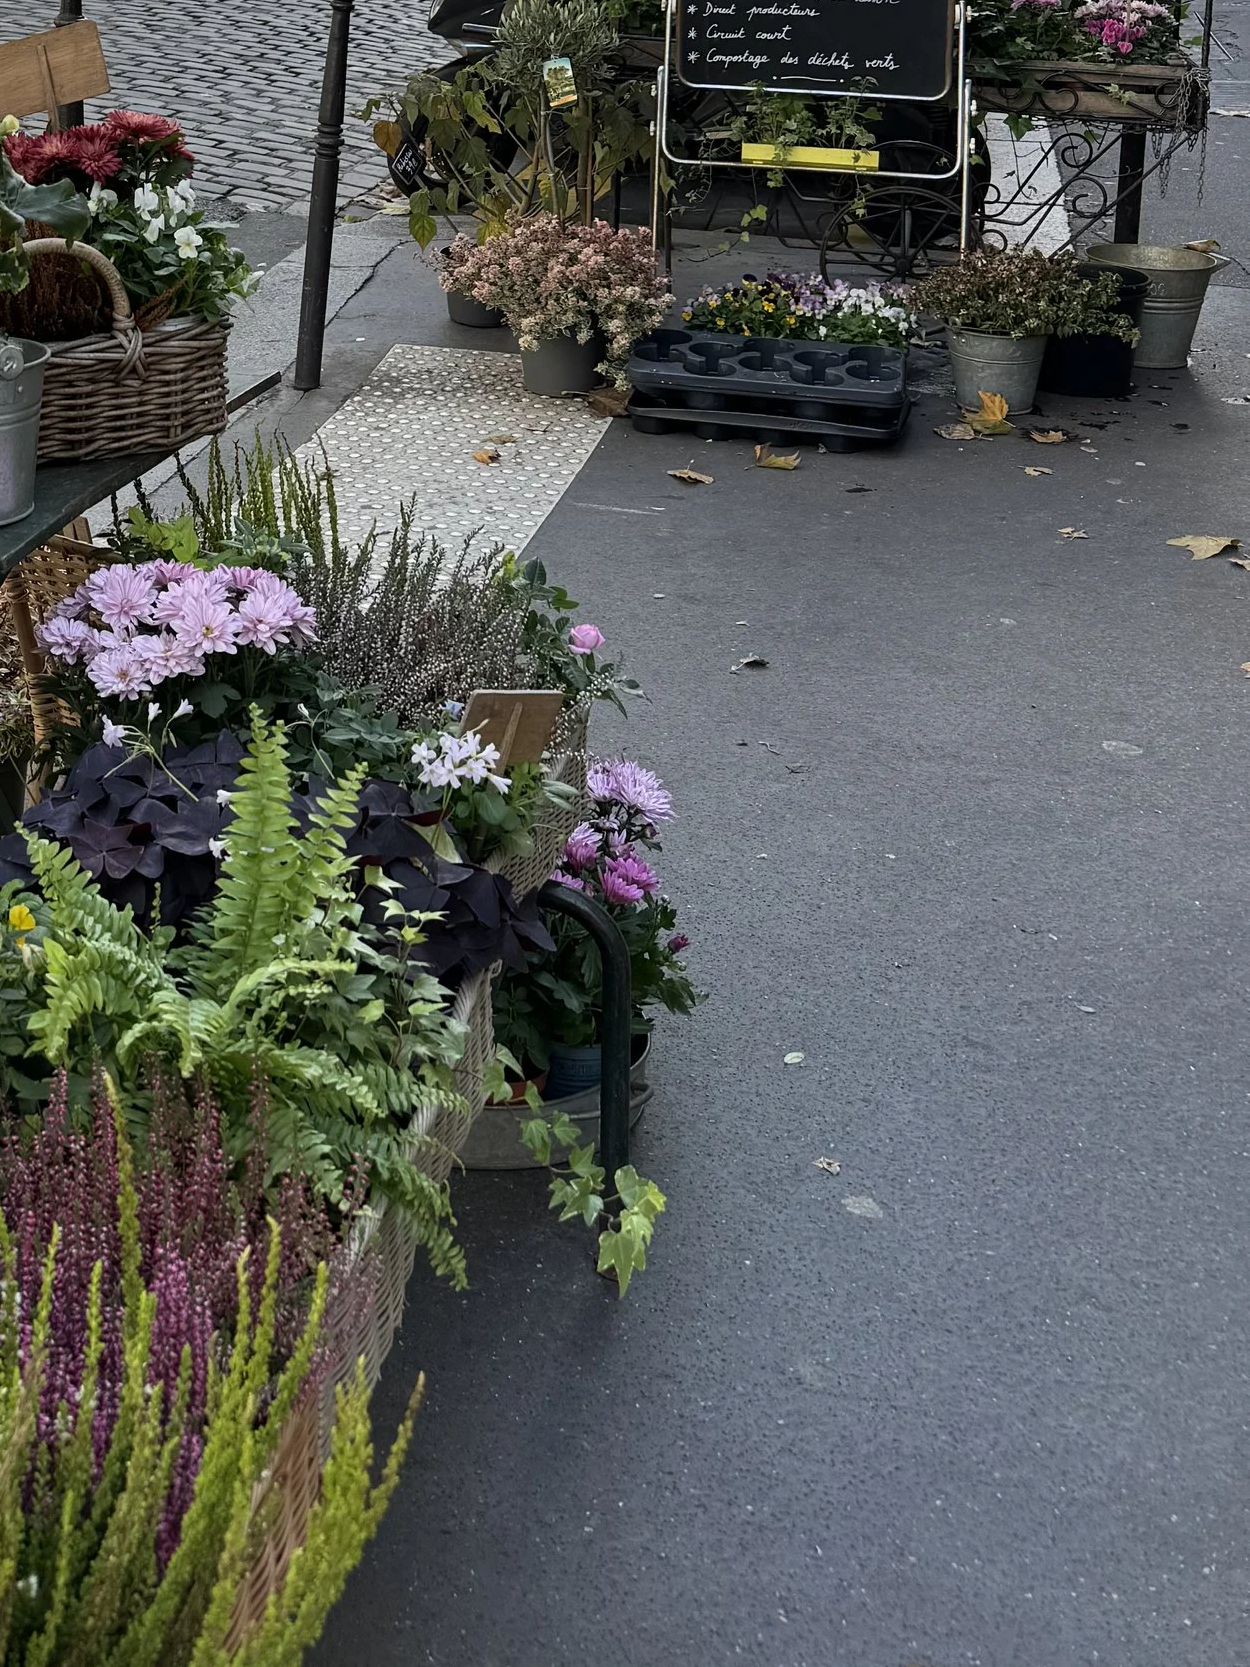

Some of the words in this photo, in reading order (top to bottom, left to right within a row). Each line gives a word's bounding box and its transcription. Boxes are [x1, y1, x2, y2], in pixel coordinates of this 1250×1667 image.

[703, 2, 737, 16] Direct
[746, 2, 821, 22] producteurs
[705, 24, 746, 40] Circuit
[755, 24, 792, 41] court
[706, 48, 771, 70] Compostage
[780, 51, 799, 65] des
[807, 51, 855, 69] déchets
[865, 53, 900, 70] verts
